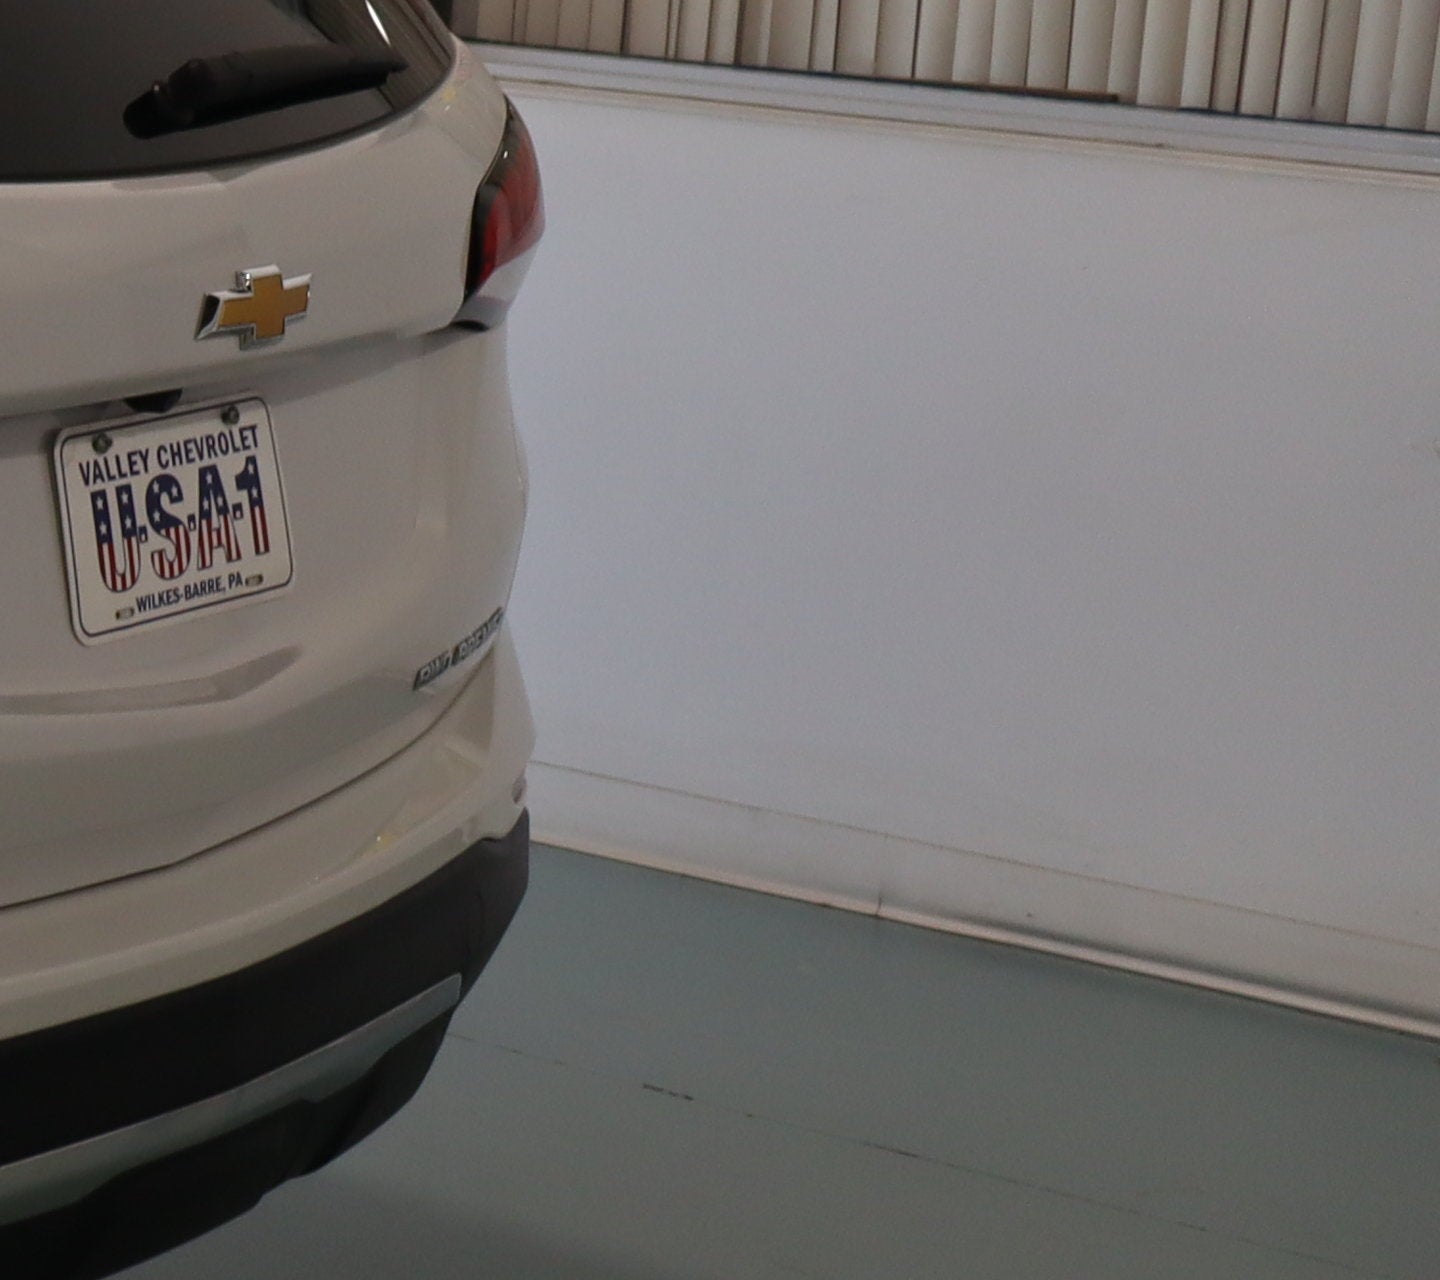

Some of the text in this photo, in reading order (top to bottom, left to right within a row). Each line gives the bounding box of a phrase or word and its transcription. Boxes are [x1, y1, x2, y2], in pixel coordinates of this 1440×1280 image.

[78, 423, 260, 488] VALLEY CHEVROLET
[227, 571, 244, 590] PA
